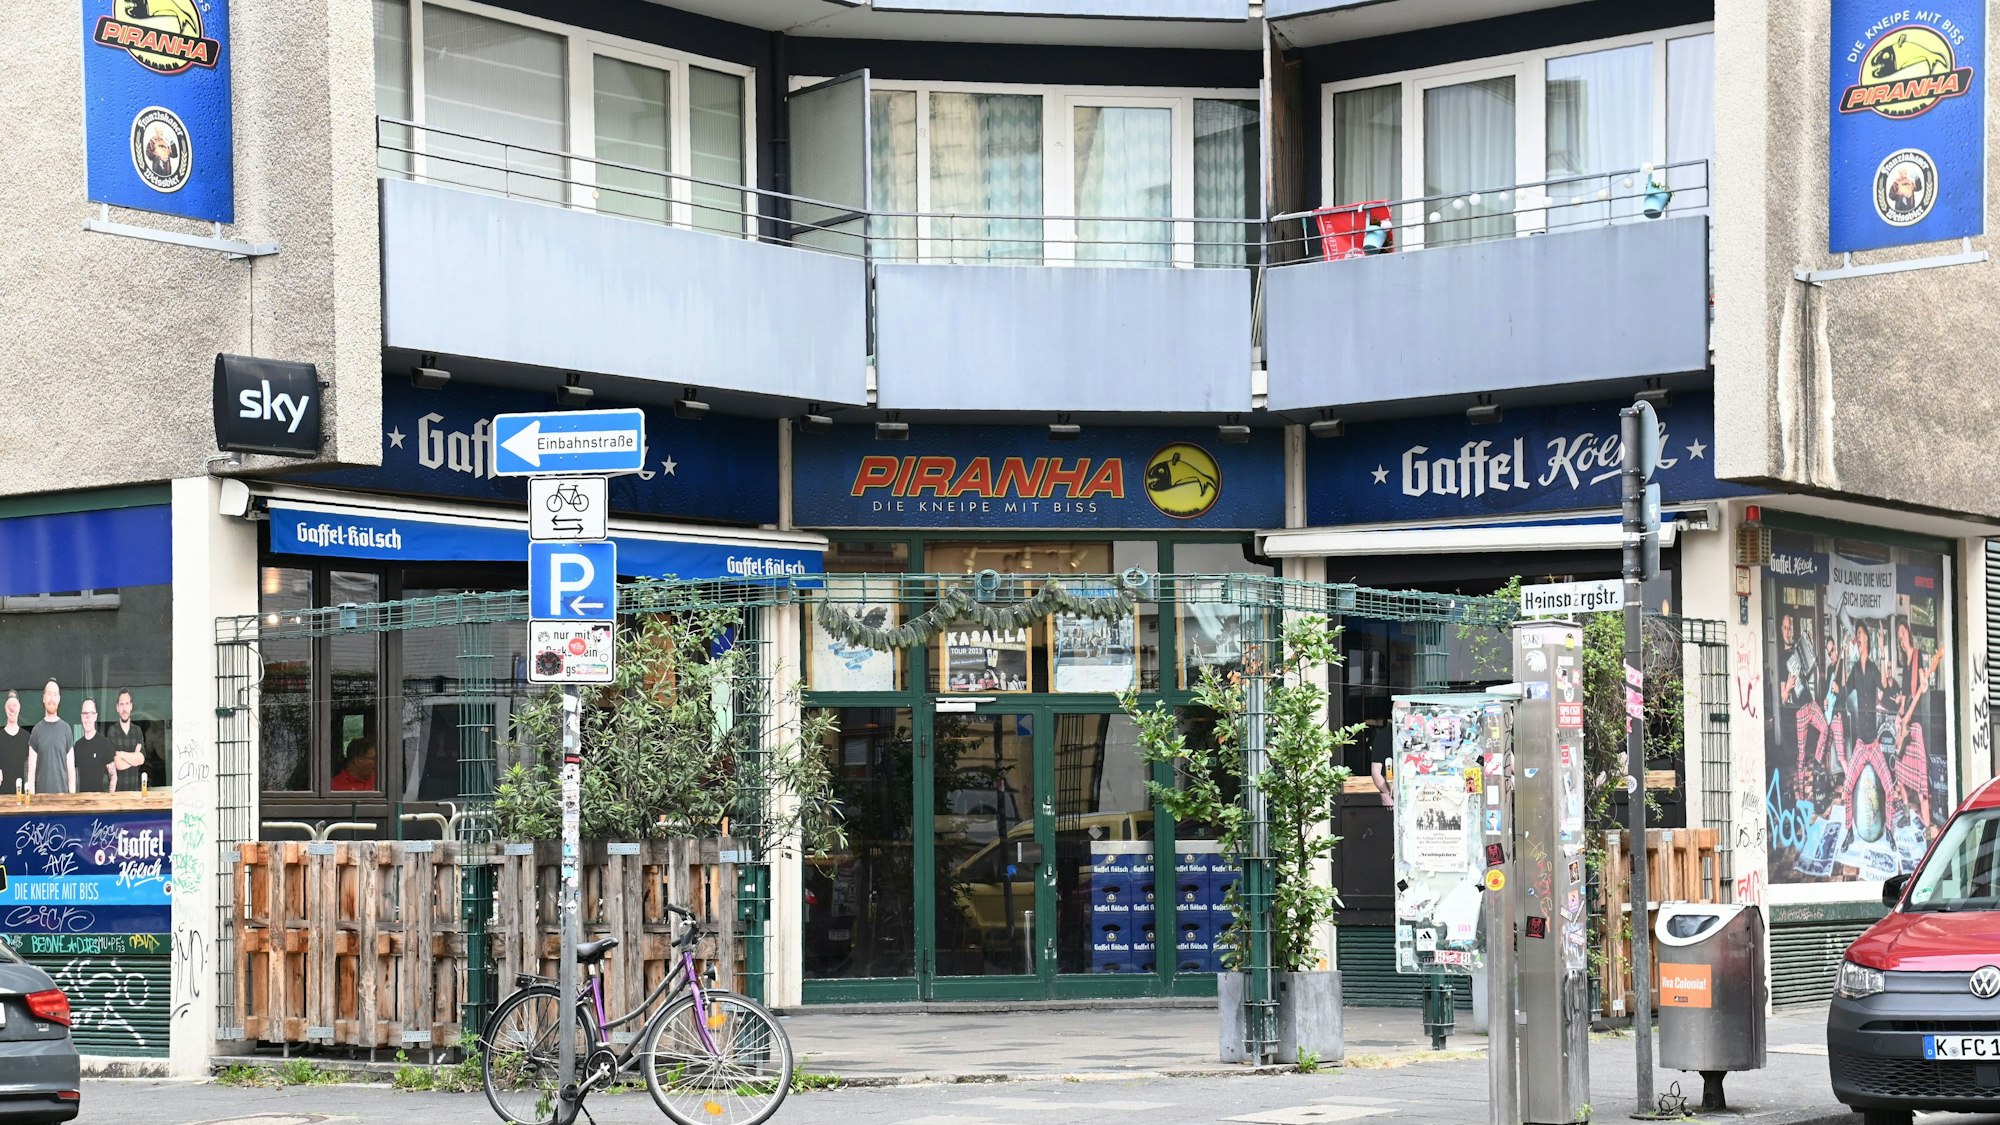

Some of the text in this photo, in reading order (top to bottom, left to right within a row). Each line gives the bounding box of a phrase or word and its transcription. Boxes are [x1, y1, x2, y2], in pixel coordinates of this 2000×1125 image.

[102, 21, 208, 62] PIRANHA
[1847, 9, 1965, 63] DIE KNEIPE MIT BISS
[1847, 74, 1960, 108] PIRANHA
[240, 380, 309, 433] sky
[537, 434, 634, 452] Einbahnstraße
[851, 456, 1125, 498] PIRANHA
[1402, 437, 1530, 498] Gaffel
[873, 501, 1098, 513] DIE KNEIPE MIT BISS
[297, 522, 402, 550] Gaffel-Kölsch
[1771, 553, 1792, 576] Gaffel
[1833, 567, 1892, 588] SU LANG DIE WELT
[550, 553, 595, 616] P
[1860, 594, 1881, 609] DRIEHT
[554, 629, 590, 640] nur mit
[118, 829, 165, 859] Gaffel
[116, 858, 165, 888] Kölsch
[14, 883, 99, 900] DIE KNEIPE MIT BISS
[1674, 977, 1707, 990] Colonia!
[1936, 1039, 1947, 1056] K
[1961, 1039, 1987, 1056] FC
